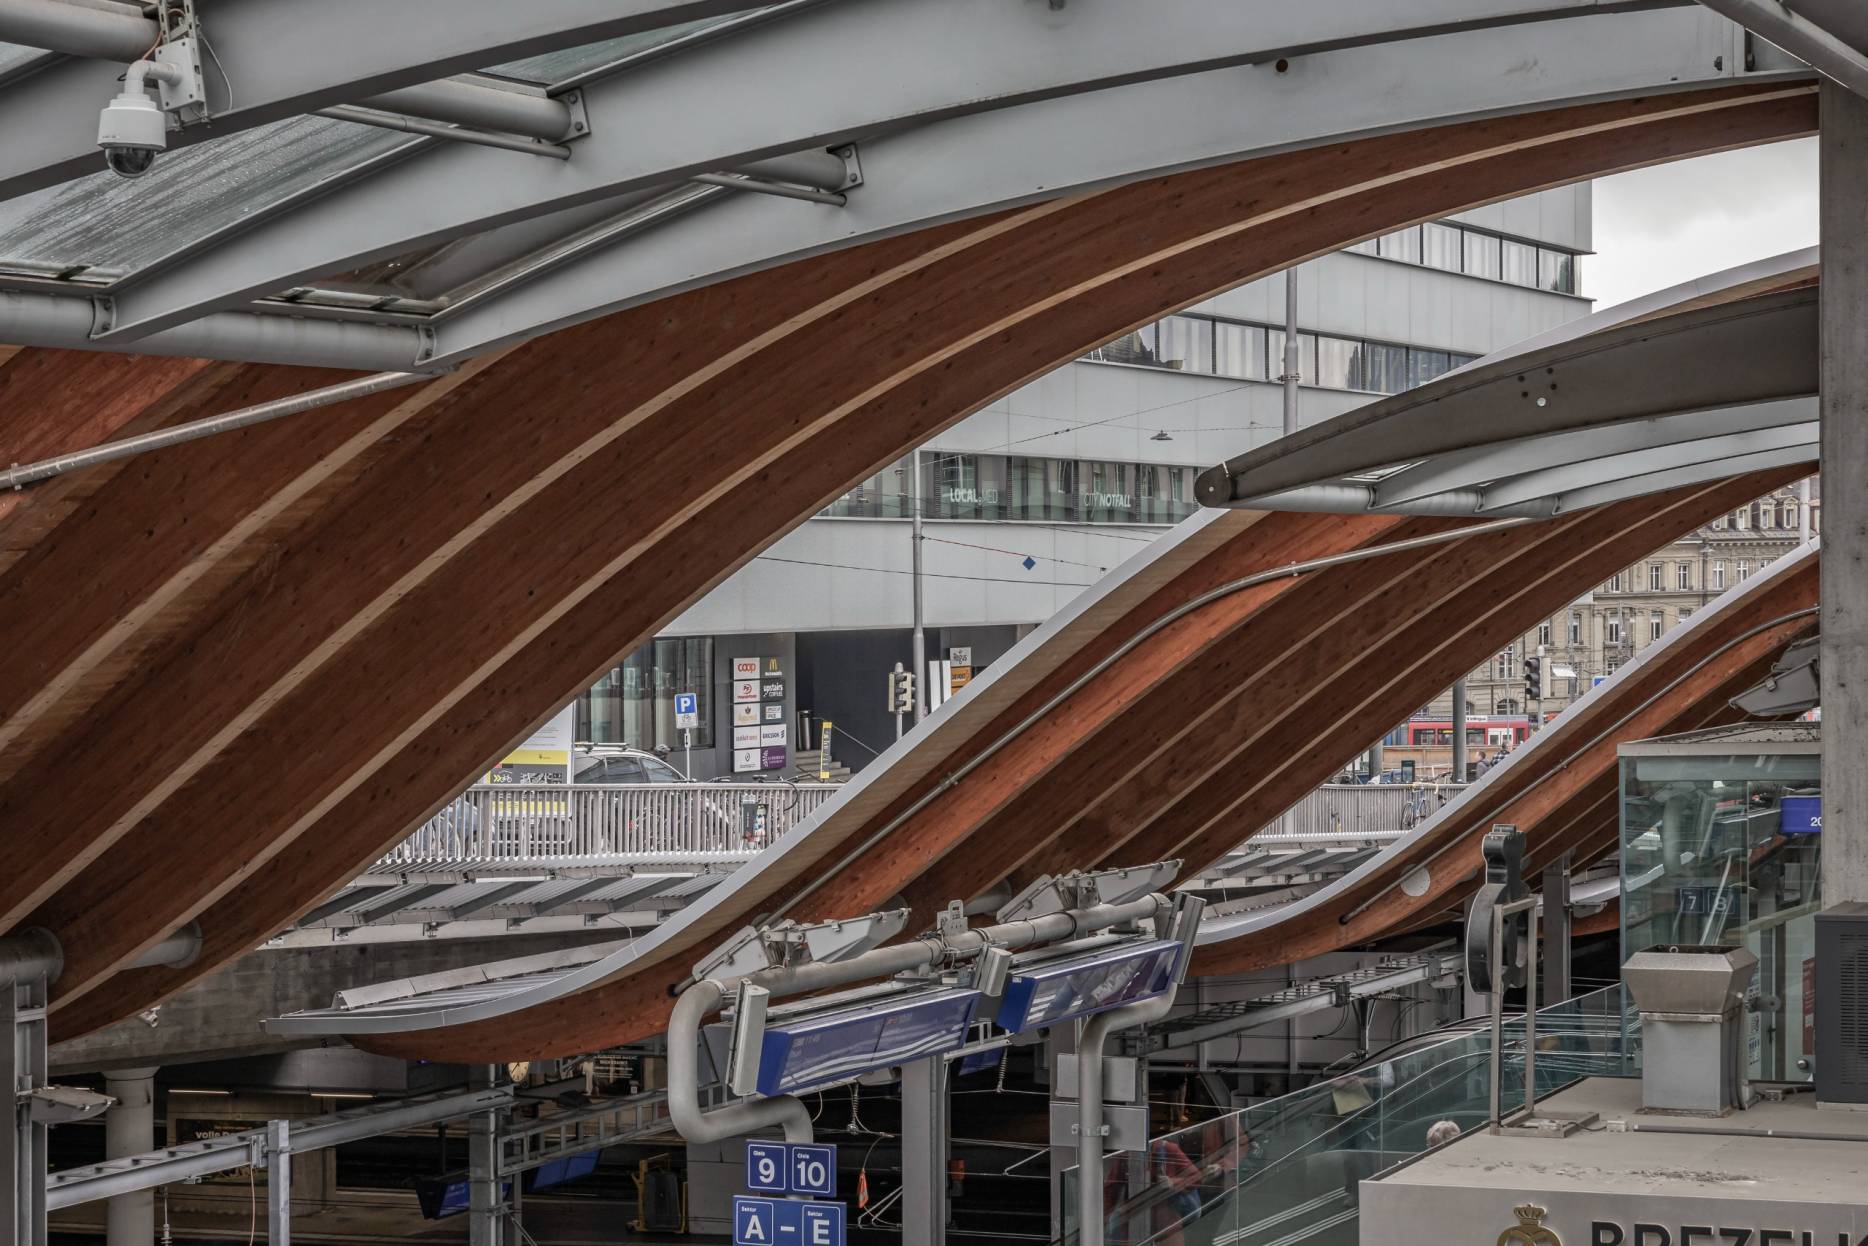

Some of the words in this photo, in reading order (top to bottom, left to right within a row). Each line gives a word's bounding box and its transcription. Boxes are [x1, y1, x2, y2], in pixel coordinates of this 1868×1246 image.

[1099, 493, 1131, 508] NOTFALL
[737, 663, 757, 673] coop
[681, 698, 691, 712] P
[1688, 896, 1696, 910] 7
[758, 1158, 775, 1183] 9
[797, 1161, 825, 1187] 10
[745, 1214, 765, 1240] A
[813, 1219, 830, 1245] E
